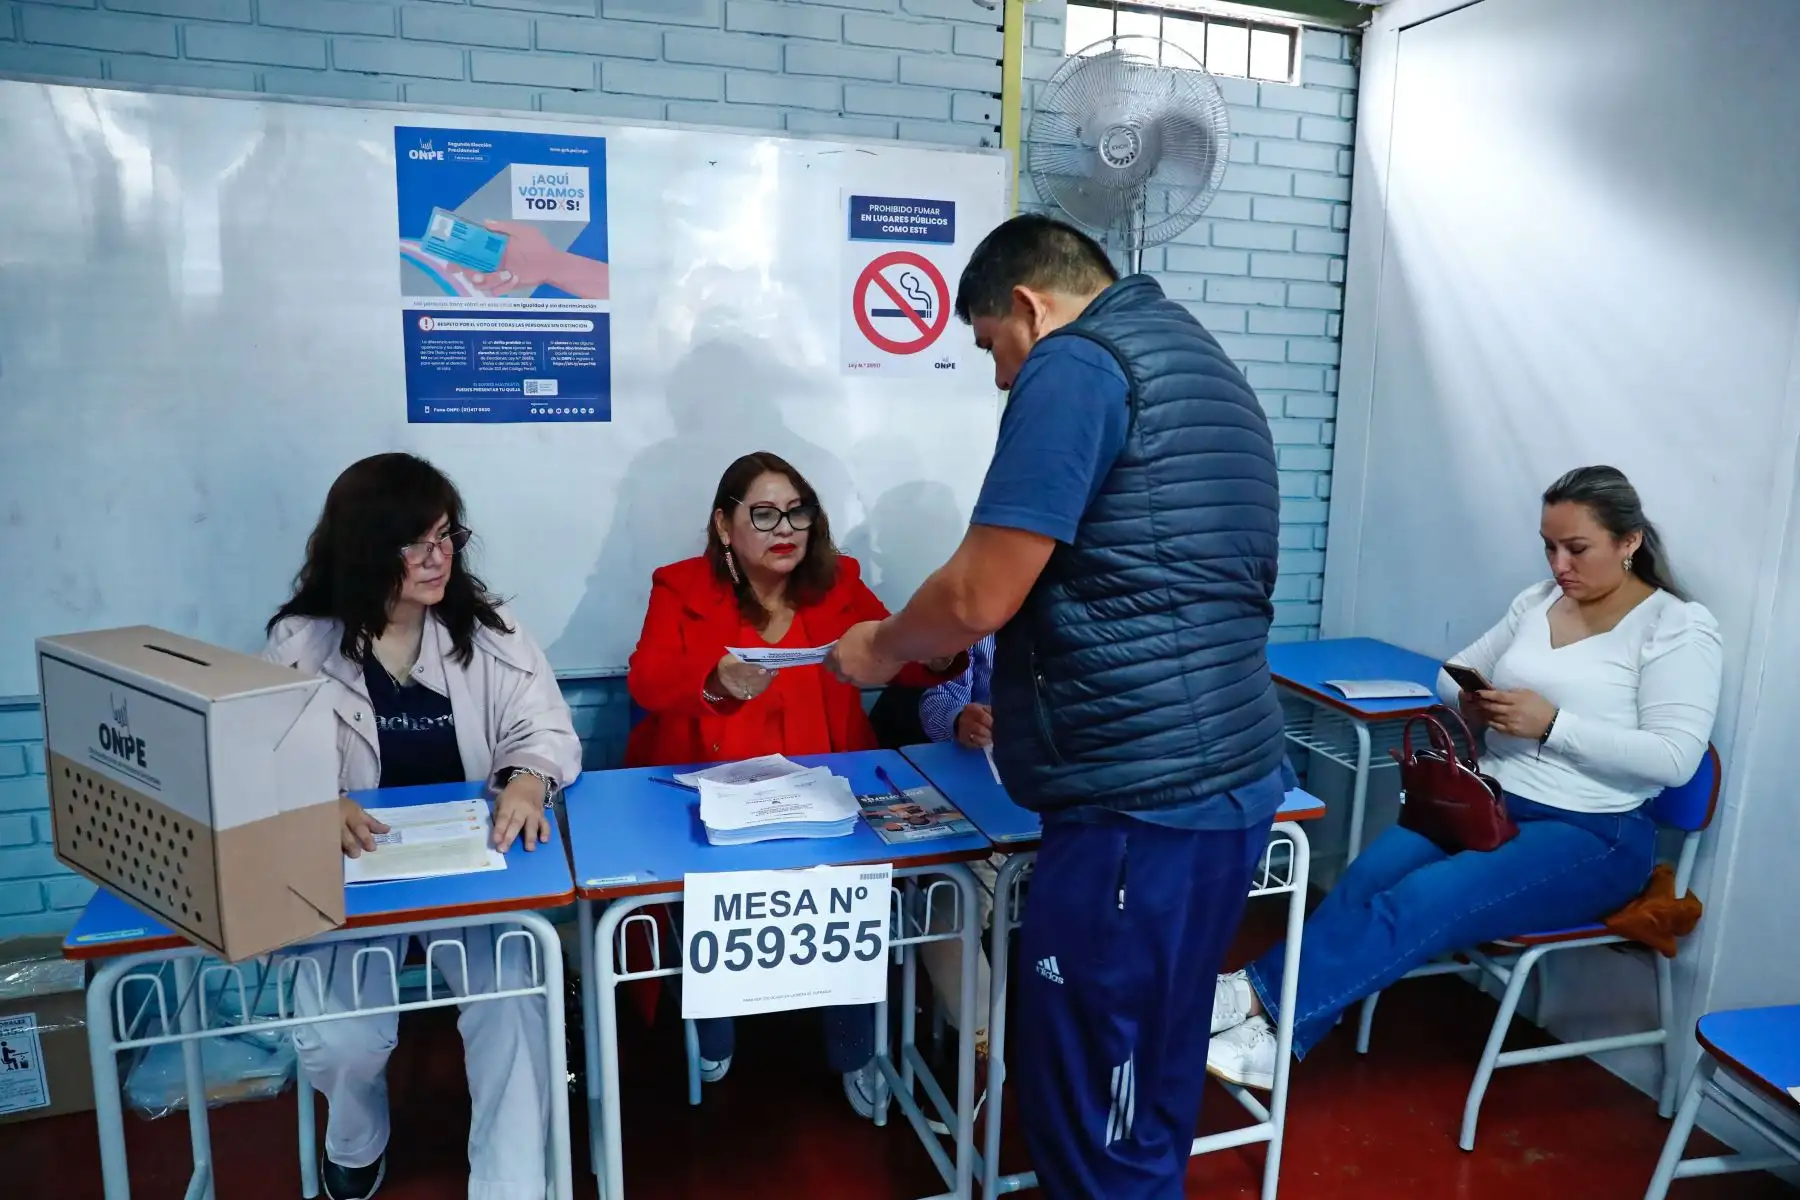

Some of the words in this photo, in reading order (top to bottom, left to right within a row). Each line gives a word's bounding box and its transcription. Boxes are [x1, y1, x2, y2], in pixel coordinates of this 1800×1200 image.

[408, 149, 445, 161] ONPE
[518, 186, 585, 199] VOTAMOS
[869, 204, 913, 214] PROHIBIDO
[914, 206, 940, 215] FUMAR
[861, 214, 872, 222] EN
[873, 214, 909, 223] LUGARES
[910, 215, 948, 226] PÚBLICOS
[882, 225, 909, 233] COMO
[909, 226, 928, 235] ESTE
[934, 362, 956, 370] ONPE
[98, 722, 147, 769] ONPE
[713, 889, 819, 922] MESA
[689, 919, 882, 975] 059355
